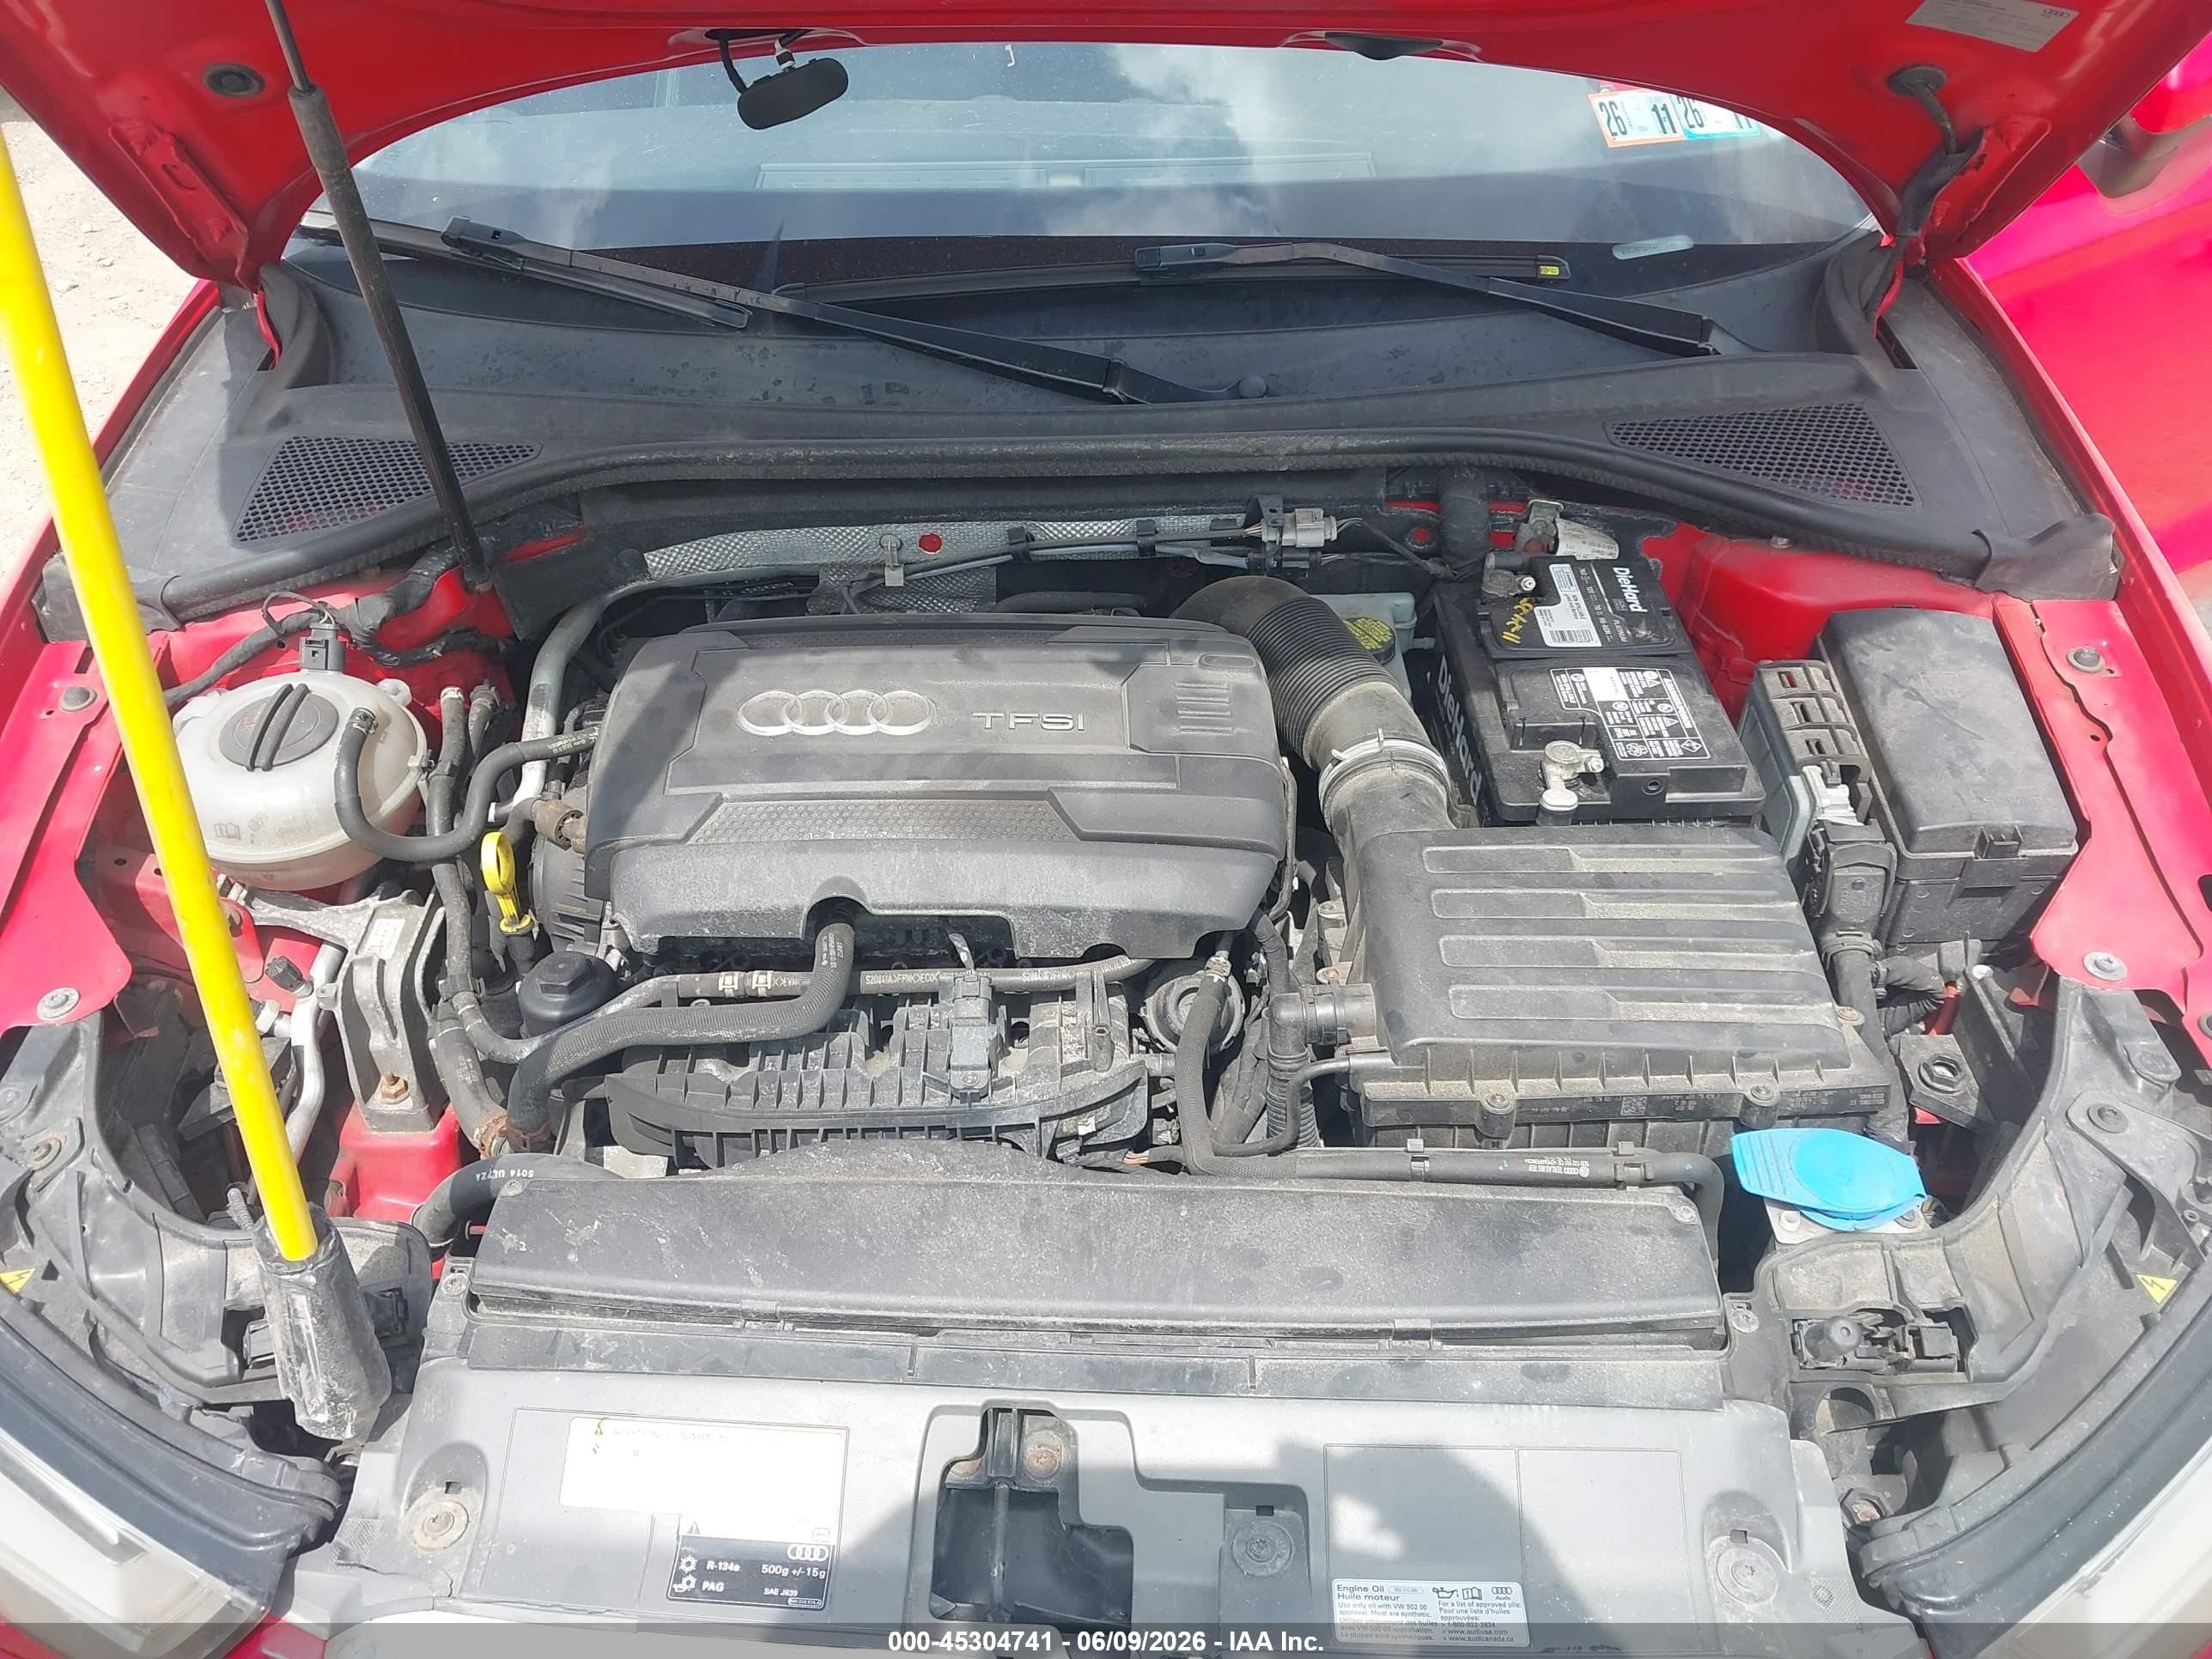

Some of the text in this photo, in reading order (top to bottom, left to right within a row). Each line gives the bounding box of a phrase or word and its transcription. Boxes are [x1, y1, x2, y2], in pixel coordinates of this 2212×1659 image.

[1599, 100, 1627, 137] 26
[1651, 103, 1677, 134] 11
[1677, 95, 1705, 129] 26
[1613, 567, 1648, 613] DieHard
[1613, 618, 1629, 643] PLATINUM
[973, 713, 1085, 731] TFSI
[1437, 653, 1482, 806] DieHard
[707, 1560, 740, 1572] R-134a
[762, 1564, 789, 1577] 500g
[702, 1581, 725, 1592] PAG
[780, 1589, 799, 1597] J639
